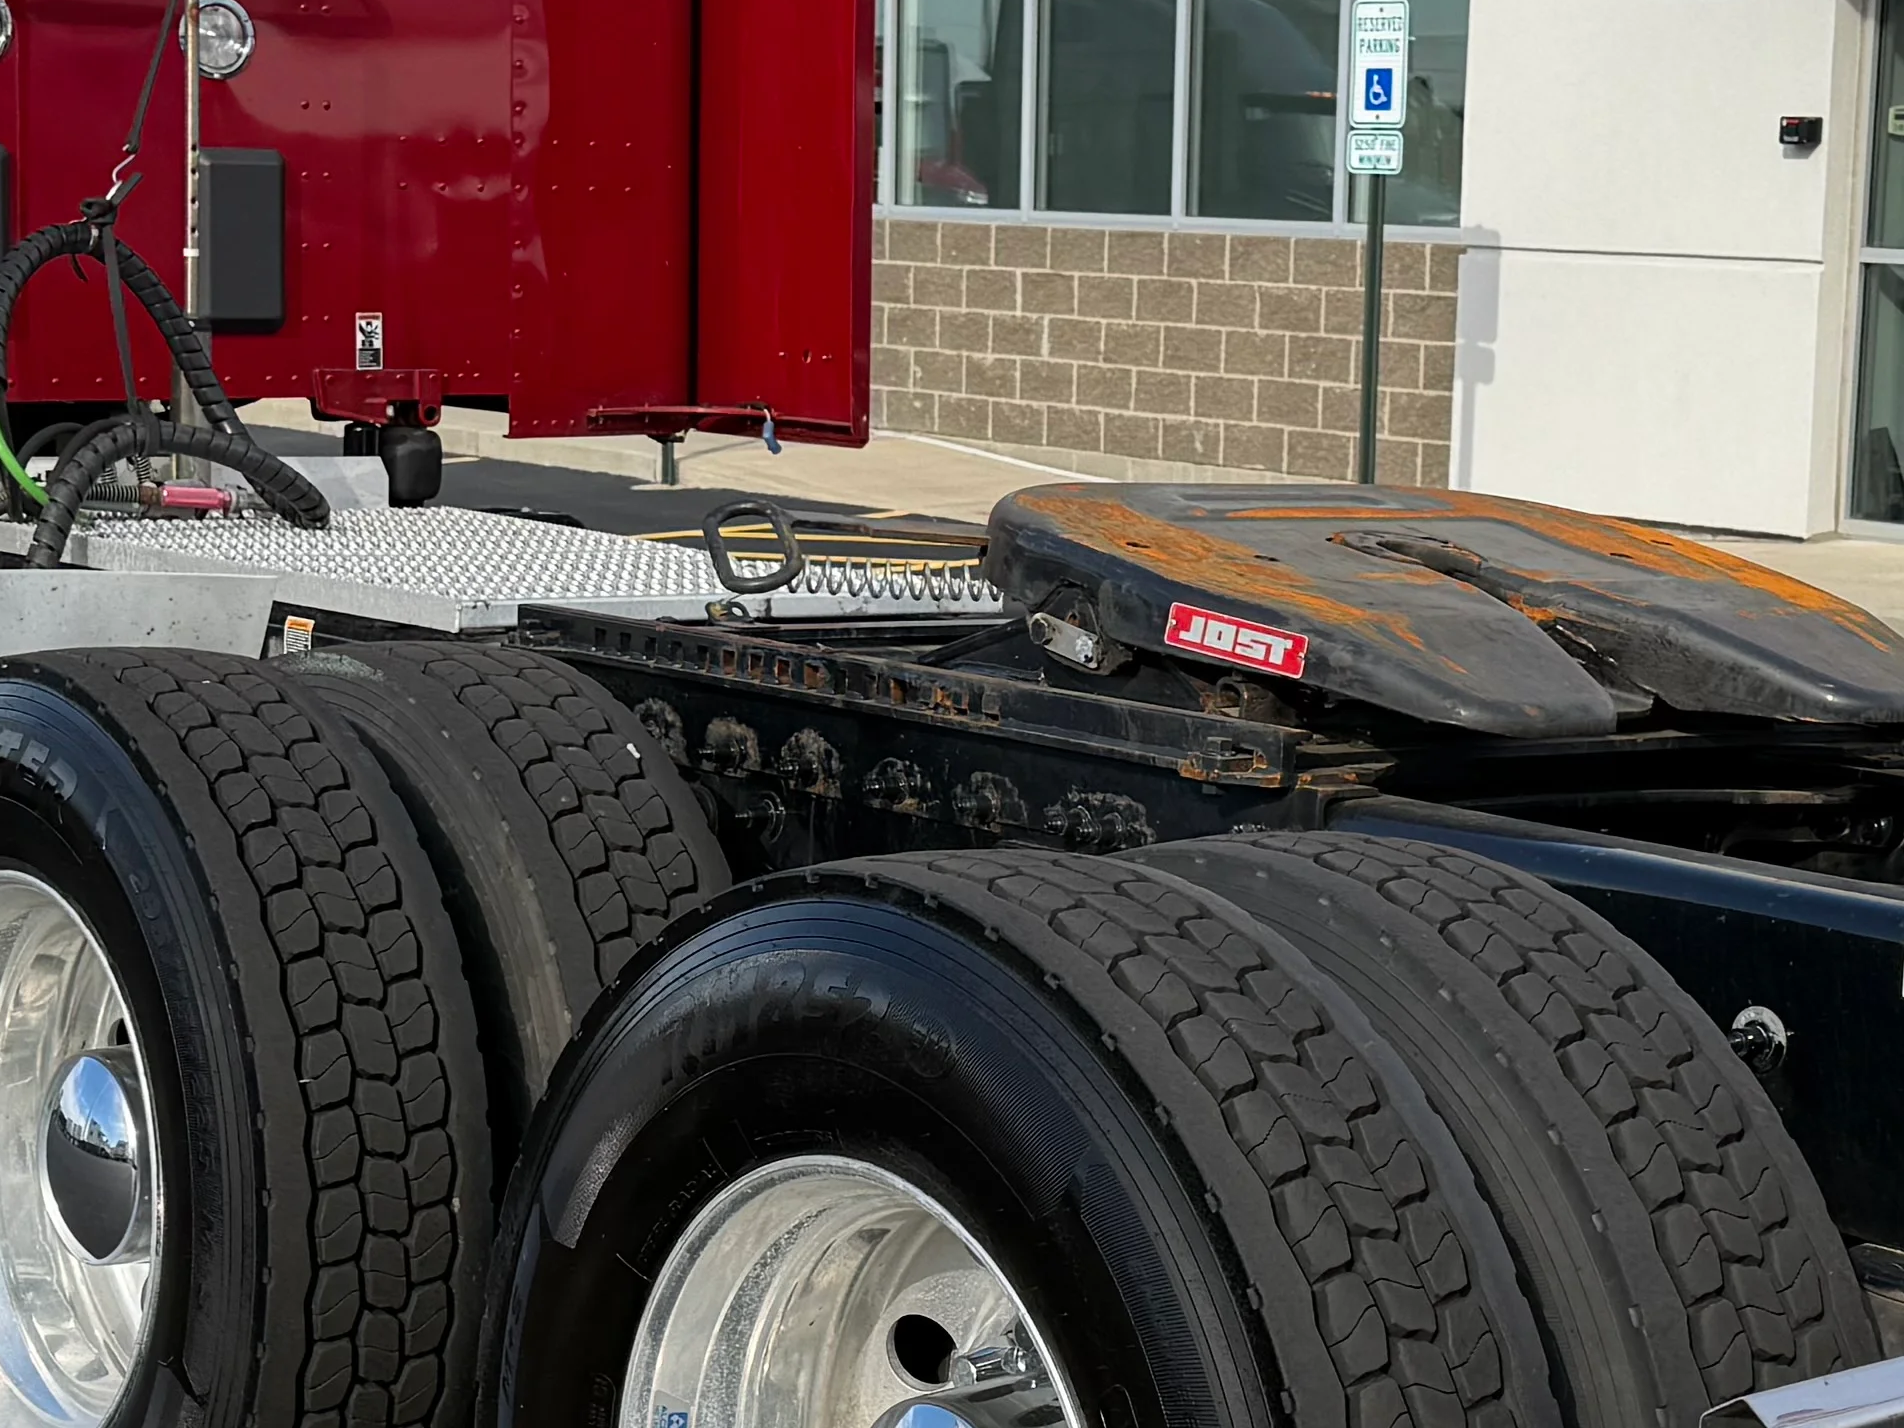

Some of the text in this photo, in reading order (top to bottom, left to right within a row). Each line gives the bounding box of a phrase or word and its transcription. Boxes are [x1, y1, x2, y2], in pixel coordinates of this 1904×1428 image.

[1357, 17, 1403, 33] RESERVED
[1359, 38, 1400, 54] PARKING
[1179, 614, 1293, 665] JOST
